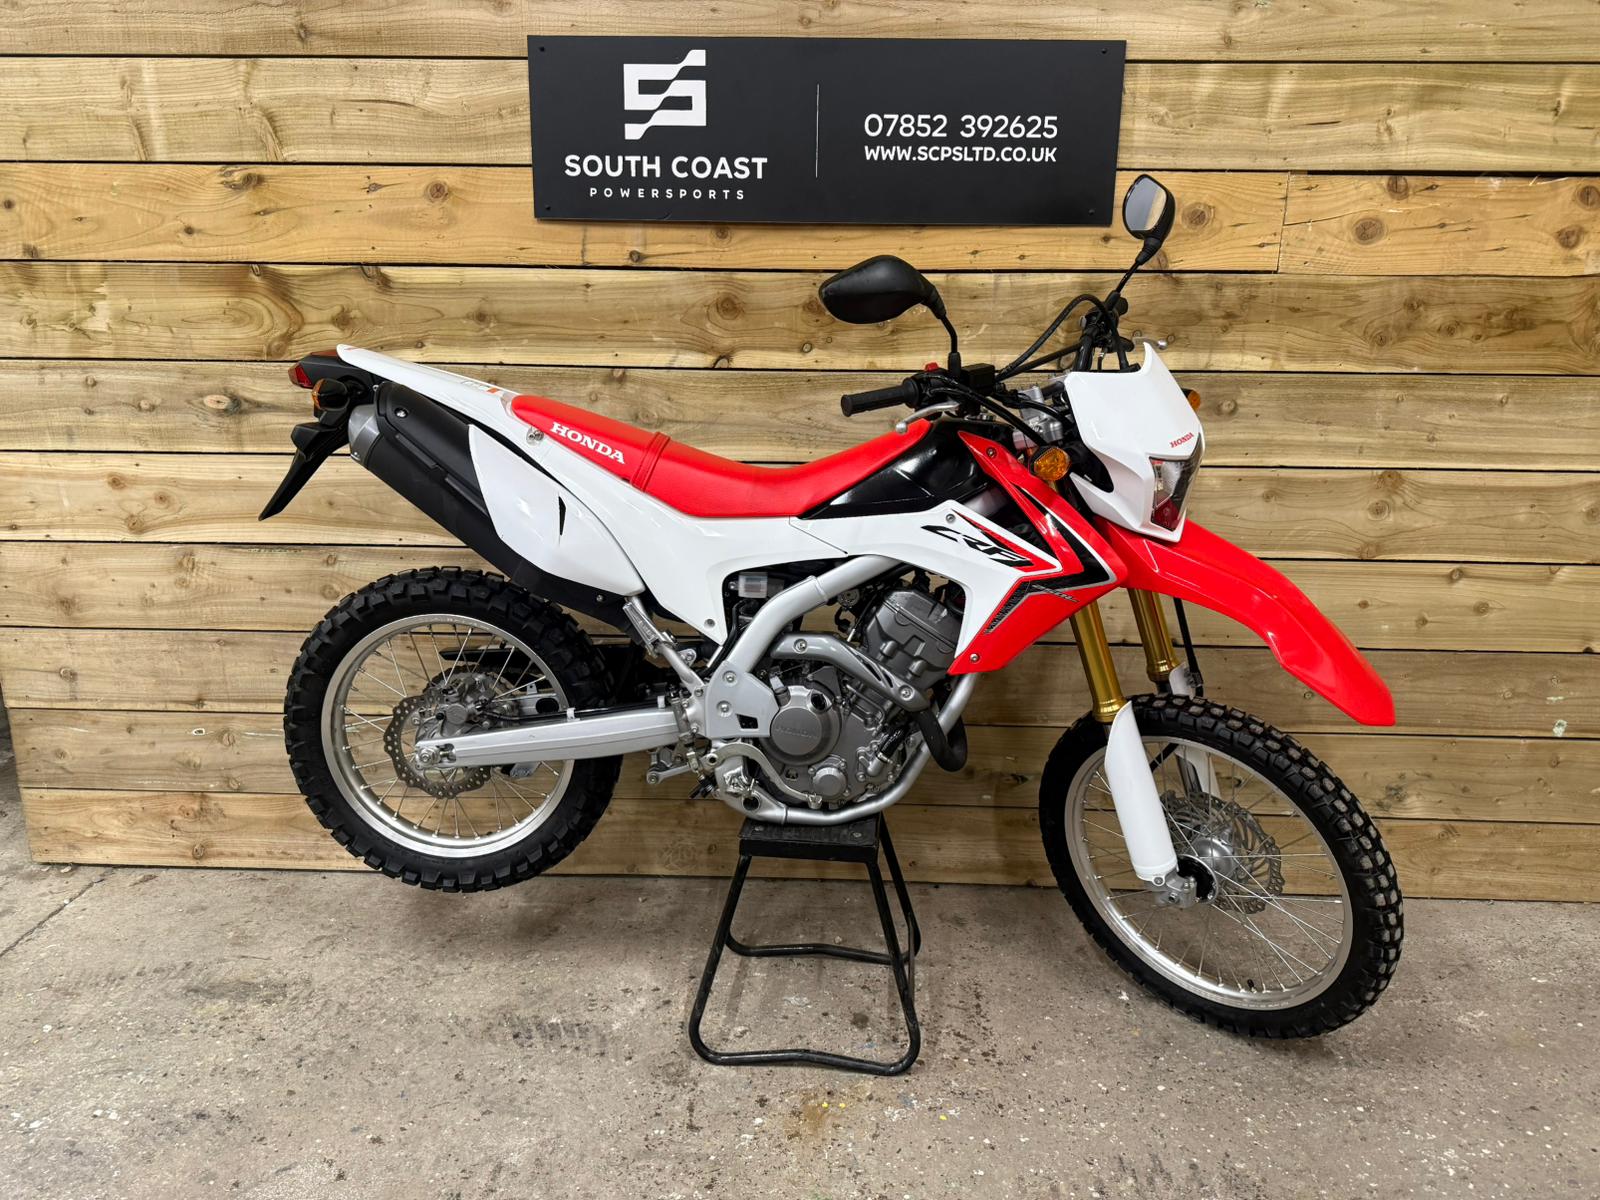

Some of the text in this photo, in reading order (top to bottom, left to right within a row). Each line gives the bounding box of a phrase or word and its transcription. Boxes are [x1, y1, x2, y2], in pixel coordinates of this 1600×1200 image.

[864, 113, 1058, 139] 07852 392625
[564, 154, 768, 180] SOUTH COAST
[864, 145, 1058, 163] WWW.SCPSLTD.CO.UK
[589, 187, 745, 200] POWERSPORTS
[550, 421, 626, 465] HONDA
